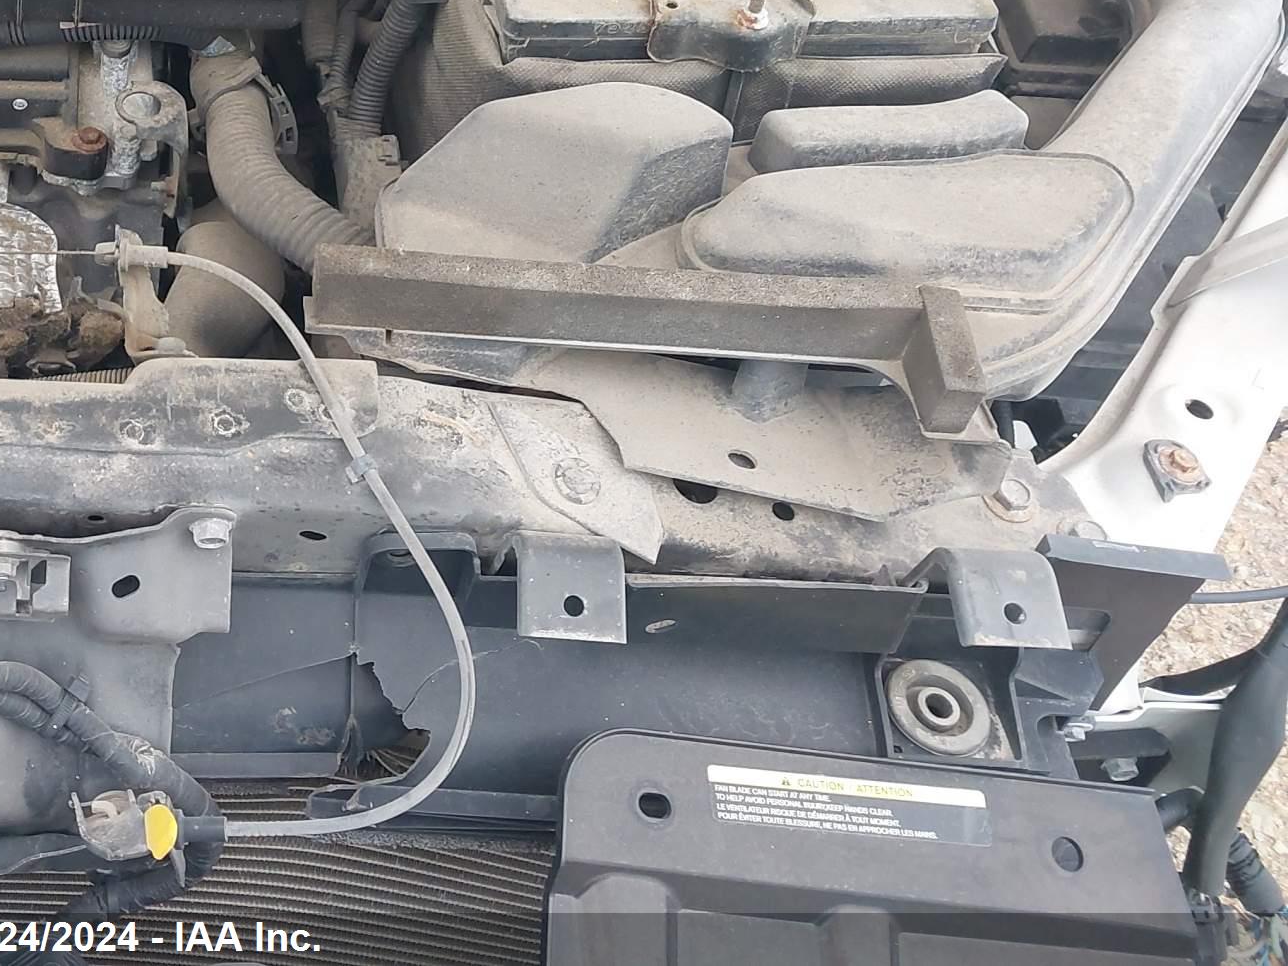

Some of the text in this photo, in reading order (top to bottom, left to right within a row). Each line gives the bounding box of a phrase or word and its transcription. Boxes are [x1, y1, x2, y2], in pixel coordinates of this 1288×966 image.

[714, 784, 728, 792] FAN
[728, 785, 751, 794] BLADE
[751, 787, 767, 795] CAN
[767, 789, 788, 797] START
[798, 792, 812, 800] ANY
[797, 778, 912, 797] CAUTION ATTENTION
[714, 792, 725, 800] TO
[726, 793, 744, 802] HELP
[744, 795, 765, 804] AVOID
[766, 797, 802, 807] PERSONAL
[716, 802, 726, 810] LE
[726, 803, 769, 814] VENTILATEUR
[769, 807, 796, 817] RISQUE
[850, 815, 868, 824] TOUT
[717, 811, 737, 820] POUR
[761, 815, 784, 824] TOUTE
[822, 821, 832, 829] NE
[832, 822, 847, 831] PAS
[858, 824, 901, 835] APPROCHER
[900, 828, 914, 837] LES
